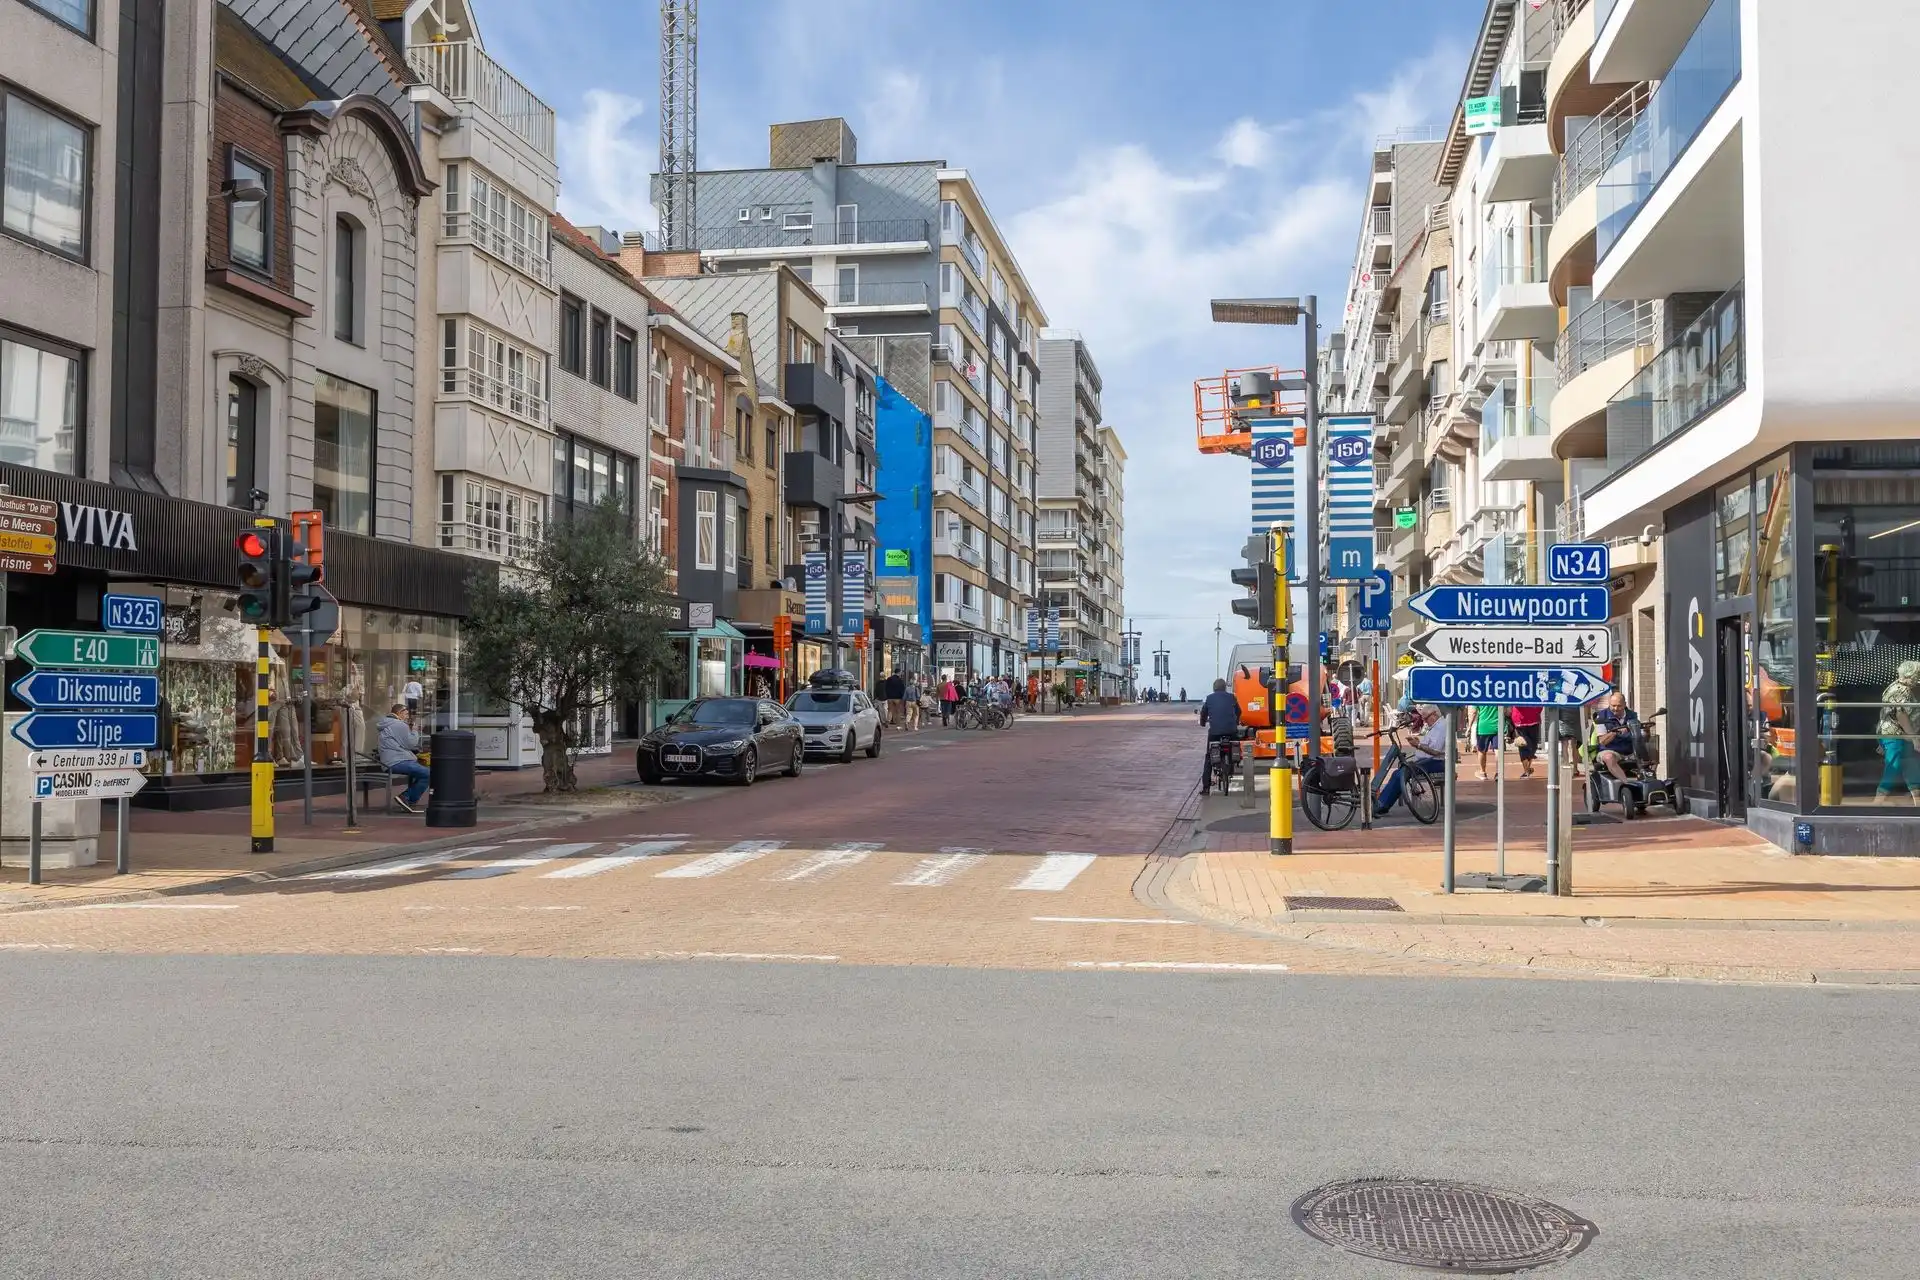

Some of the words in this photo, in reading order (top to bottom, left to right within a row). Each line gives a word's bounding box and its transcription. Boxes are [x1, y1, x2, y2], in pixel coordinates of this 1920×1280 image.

[1260, 444, 1286, 459] 150
[1337, 441, 1363, 457] 150
[0, 500, 25, 511] usthuis
[12, 518, 41, 532] Meers
[61, 502, 137, 550] VIVA
[1556, 551, 1601, 575] N34
[112, 602, 155, 626] N325
[1458, 592, 1588, 622] Nieuwpoort
[1361, 617, 1373, 628] 30
[1376, 619, 1389, 628] MIN
[1450, 637, 1564, 655] Westende-Bad
[58, 677, 142, 703] Diksmuide
[77, 719, 122, 748] Slijpe
[53, 754, 94, 768] Centrum
[97, 753, 117, 766] 339
[119, 753, 128, 767] pl
[53, 773, 92, 788] CASINO
[103, 778, 130, 787] betFIRST
[55, 789, 88, 797] MIDDELKERKE
